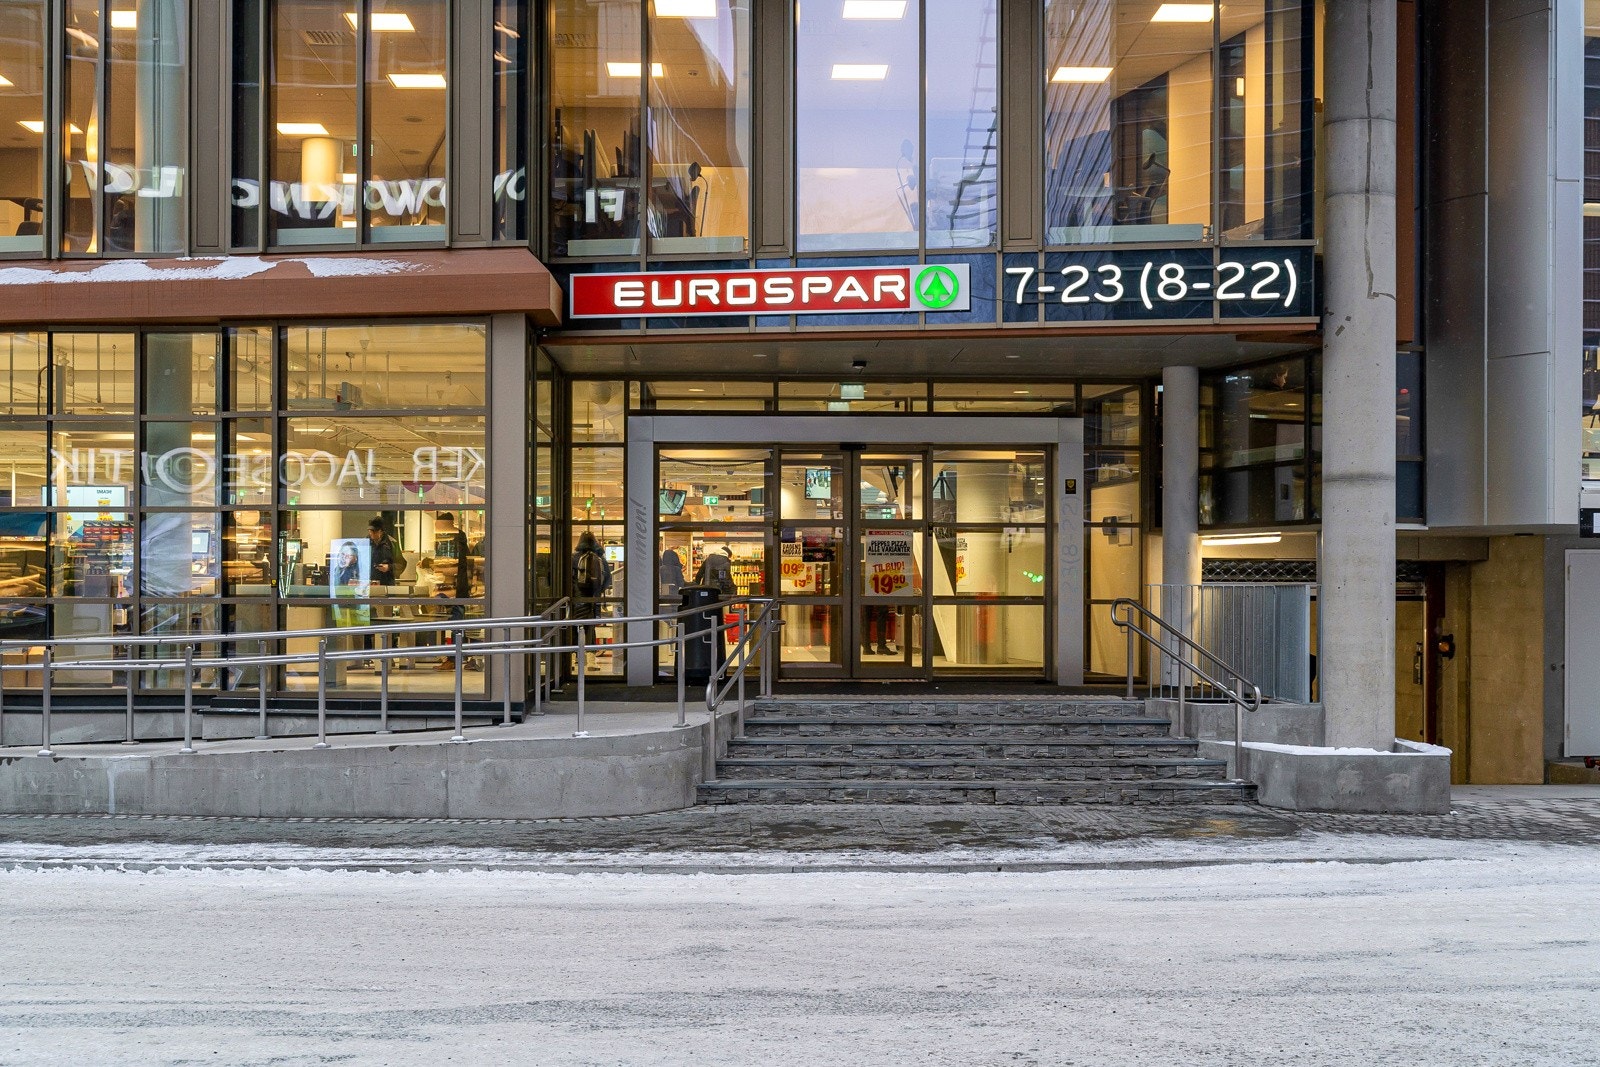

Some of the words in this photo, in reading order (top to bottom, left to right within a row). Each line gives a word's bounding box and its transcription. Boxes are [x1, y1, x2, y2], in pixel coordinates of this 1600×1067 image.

[613, 275, 906, 307] EUROSPAR
[1005, 264, 1124, 305] 7-23
[1140, 259, 1297, 310] (8-22)
[873, 561, 905, 573] TILBUD!
